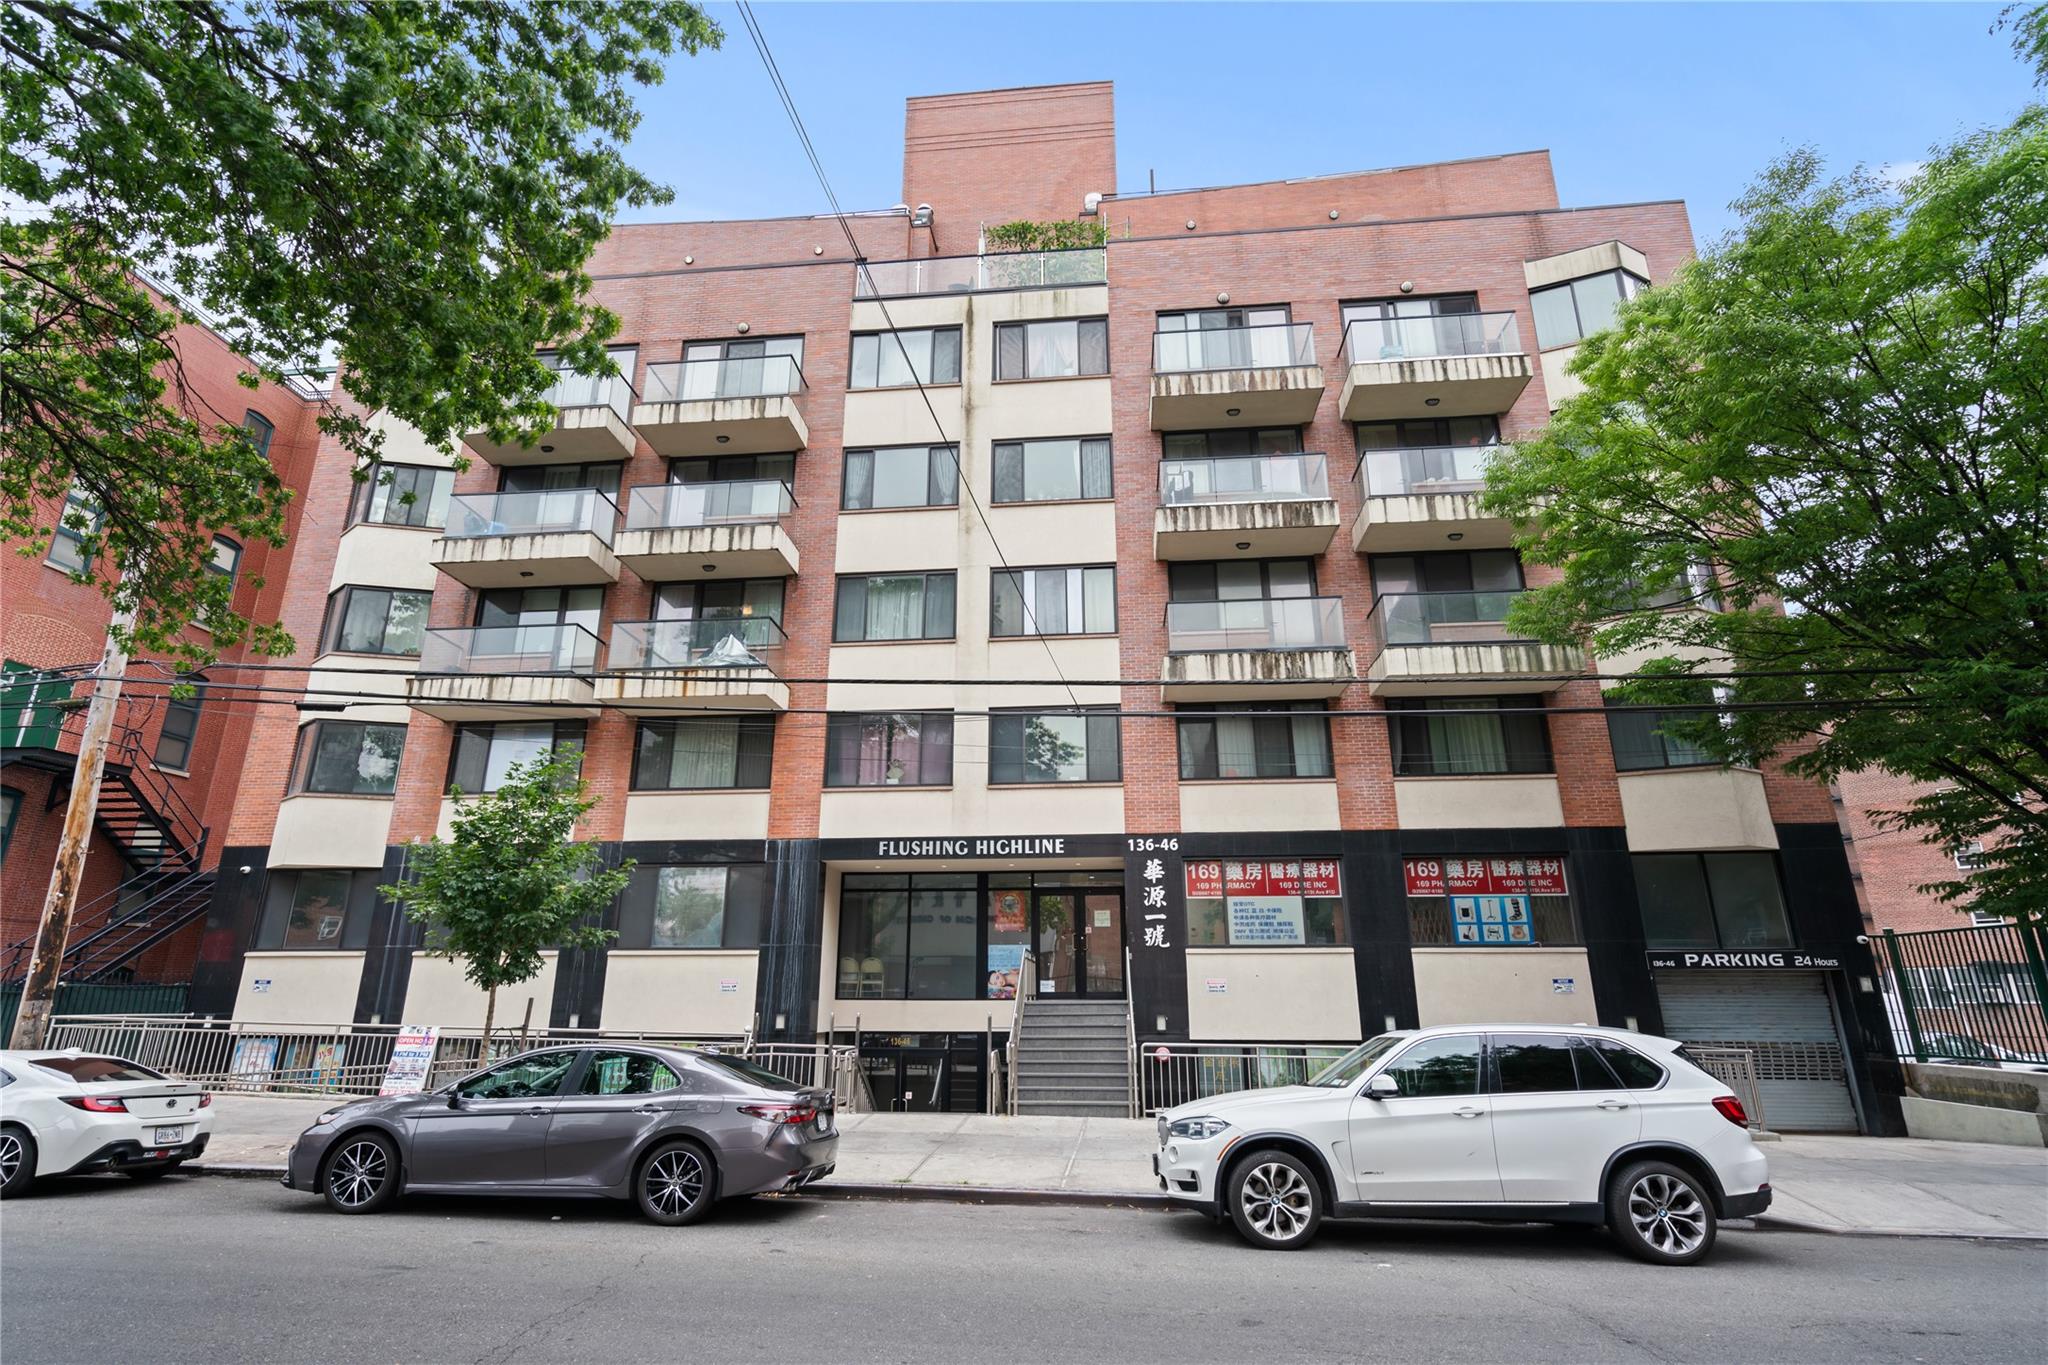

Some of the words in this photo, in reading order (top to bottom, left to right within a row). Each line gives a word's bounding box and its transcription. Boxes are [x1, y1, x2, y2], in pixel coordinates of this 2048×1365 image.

[878, 840, 968, 856] FLUSHING
[976, 838, 1065, 854] HIGHLINE
[1127, 838, 1179, 852] 136-46
[1188, 864, 1219, 880] 169
[1226, 862, 1262, 880] 藥房
[1270, 862, 1335, 879] 醫療器材
[1406, 861, 1439, 877] 169
[1446, 860, 1484, 878] 藥房
[1490, 860, 1559, 876] 醫療器材
[1143, 858, 1171, 948] 華源一號
[1684, 953, 1785, 966] PARKING
[1794, 955, 1812, 966] 24
[1814, 958, 1838, 966] Hours
